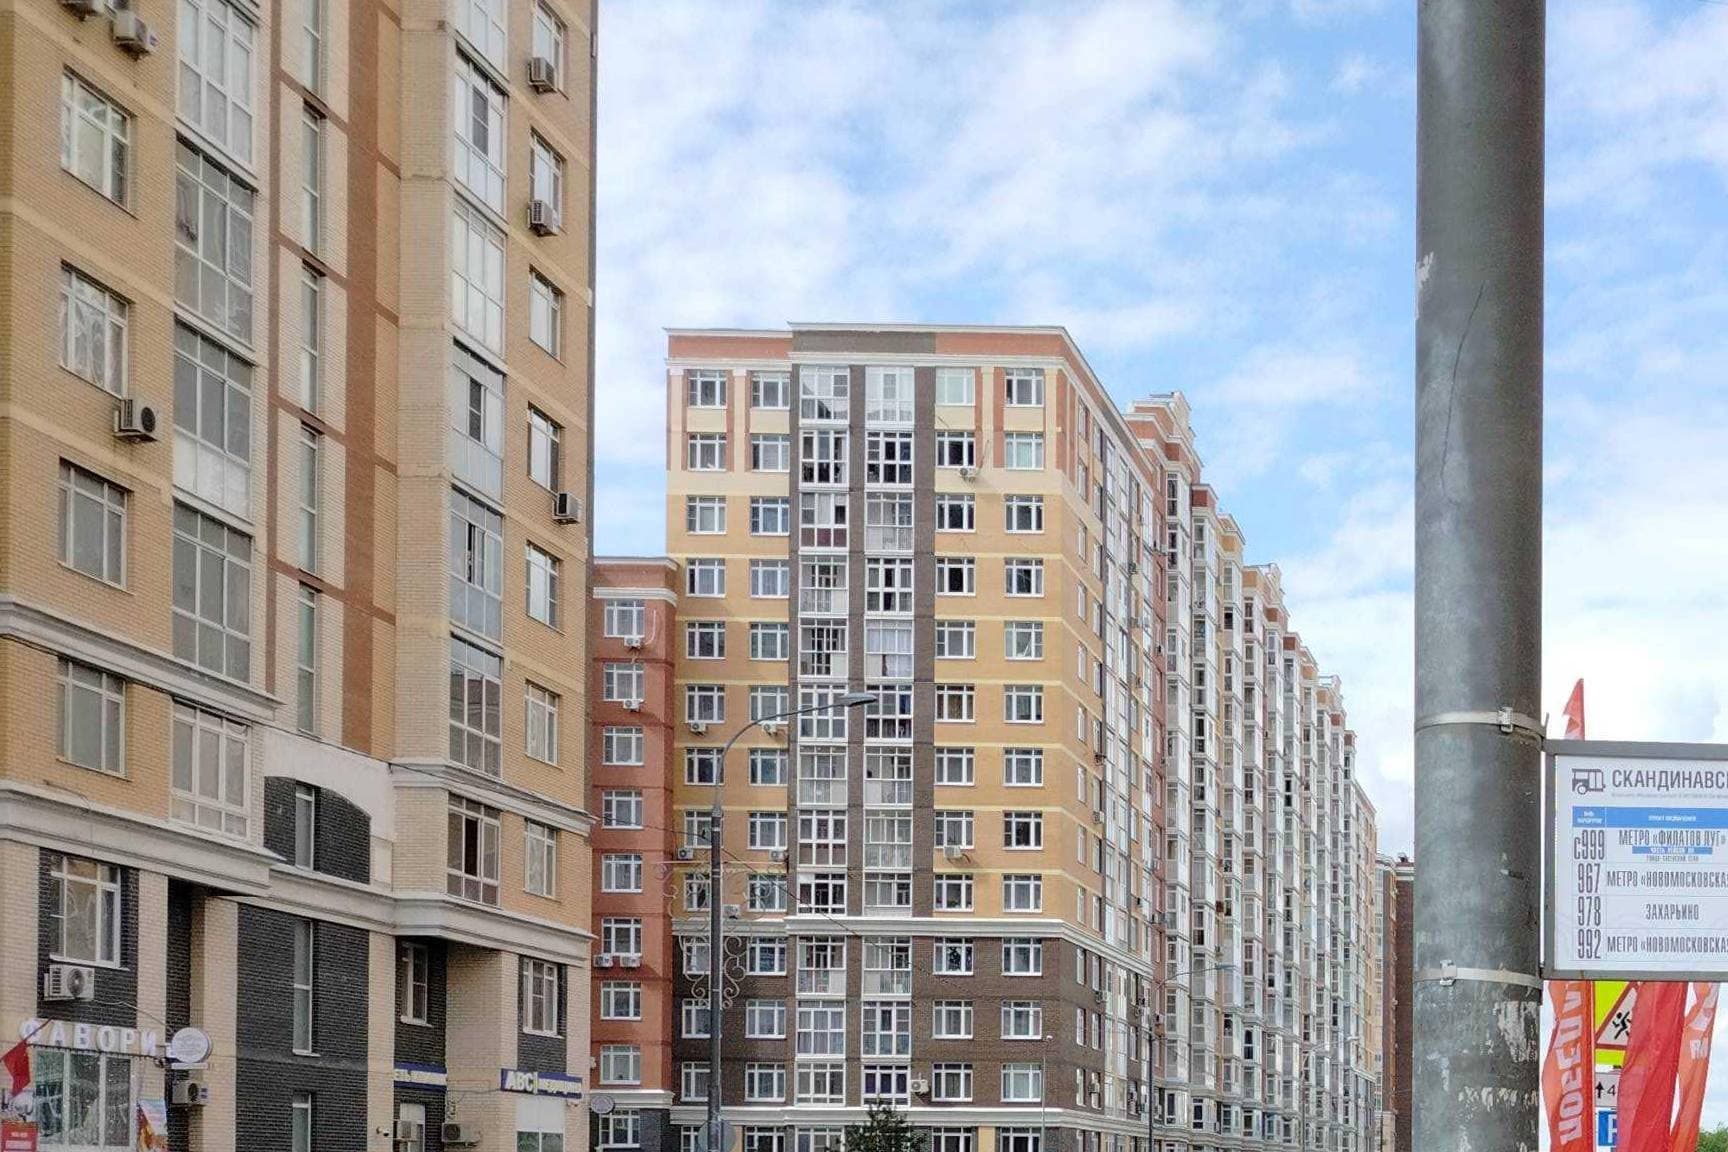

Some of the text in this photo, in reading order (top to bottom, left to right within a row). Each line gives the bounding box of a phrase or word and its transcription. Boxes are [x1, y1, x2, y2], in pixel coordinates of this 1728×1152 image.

[1619, 830, 1650, 845] МЕТРО
[1577, 863, 1600, 894] 967
[1607, 871, 1638, 887] МЕТРО
[1577, 896, 1700, 926] 978 ЗАХАРЬИНО
[1577, 929, 1600, 959] 992
[1607, 936, 1638, 952] МЕТРО
[20, 1017, 157, 1057] ФАВОРИ
